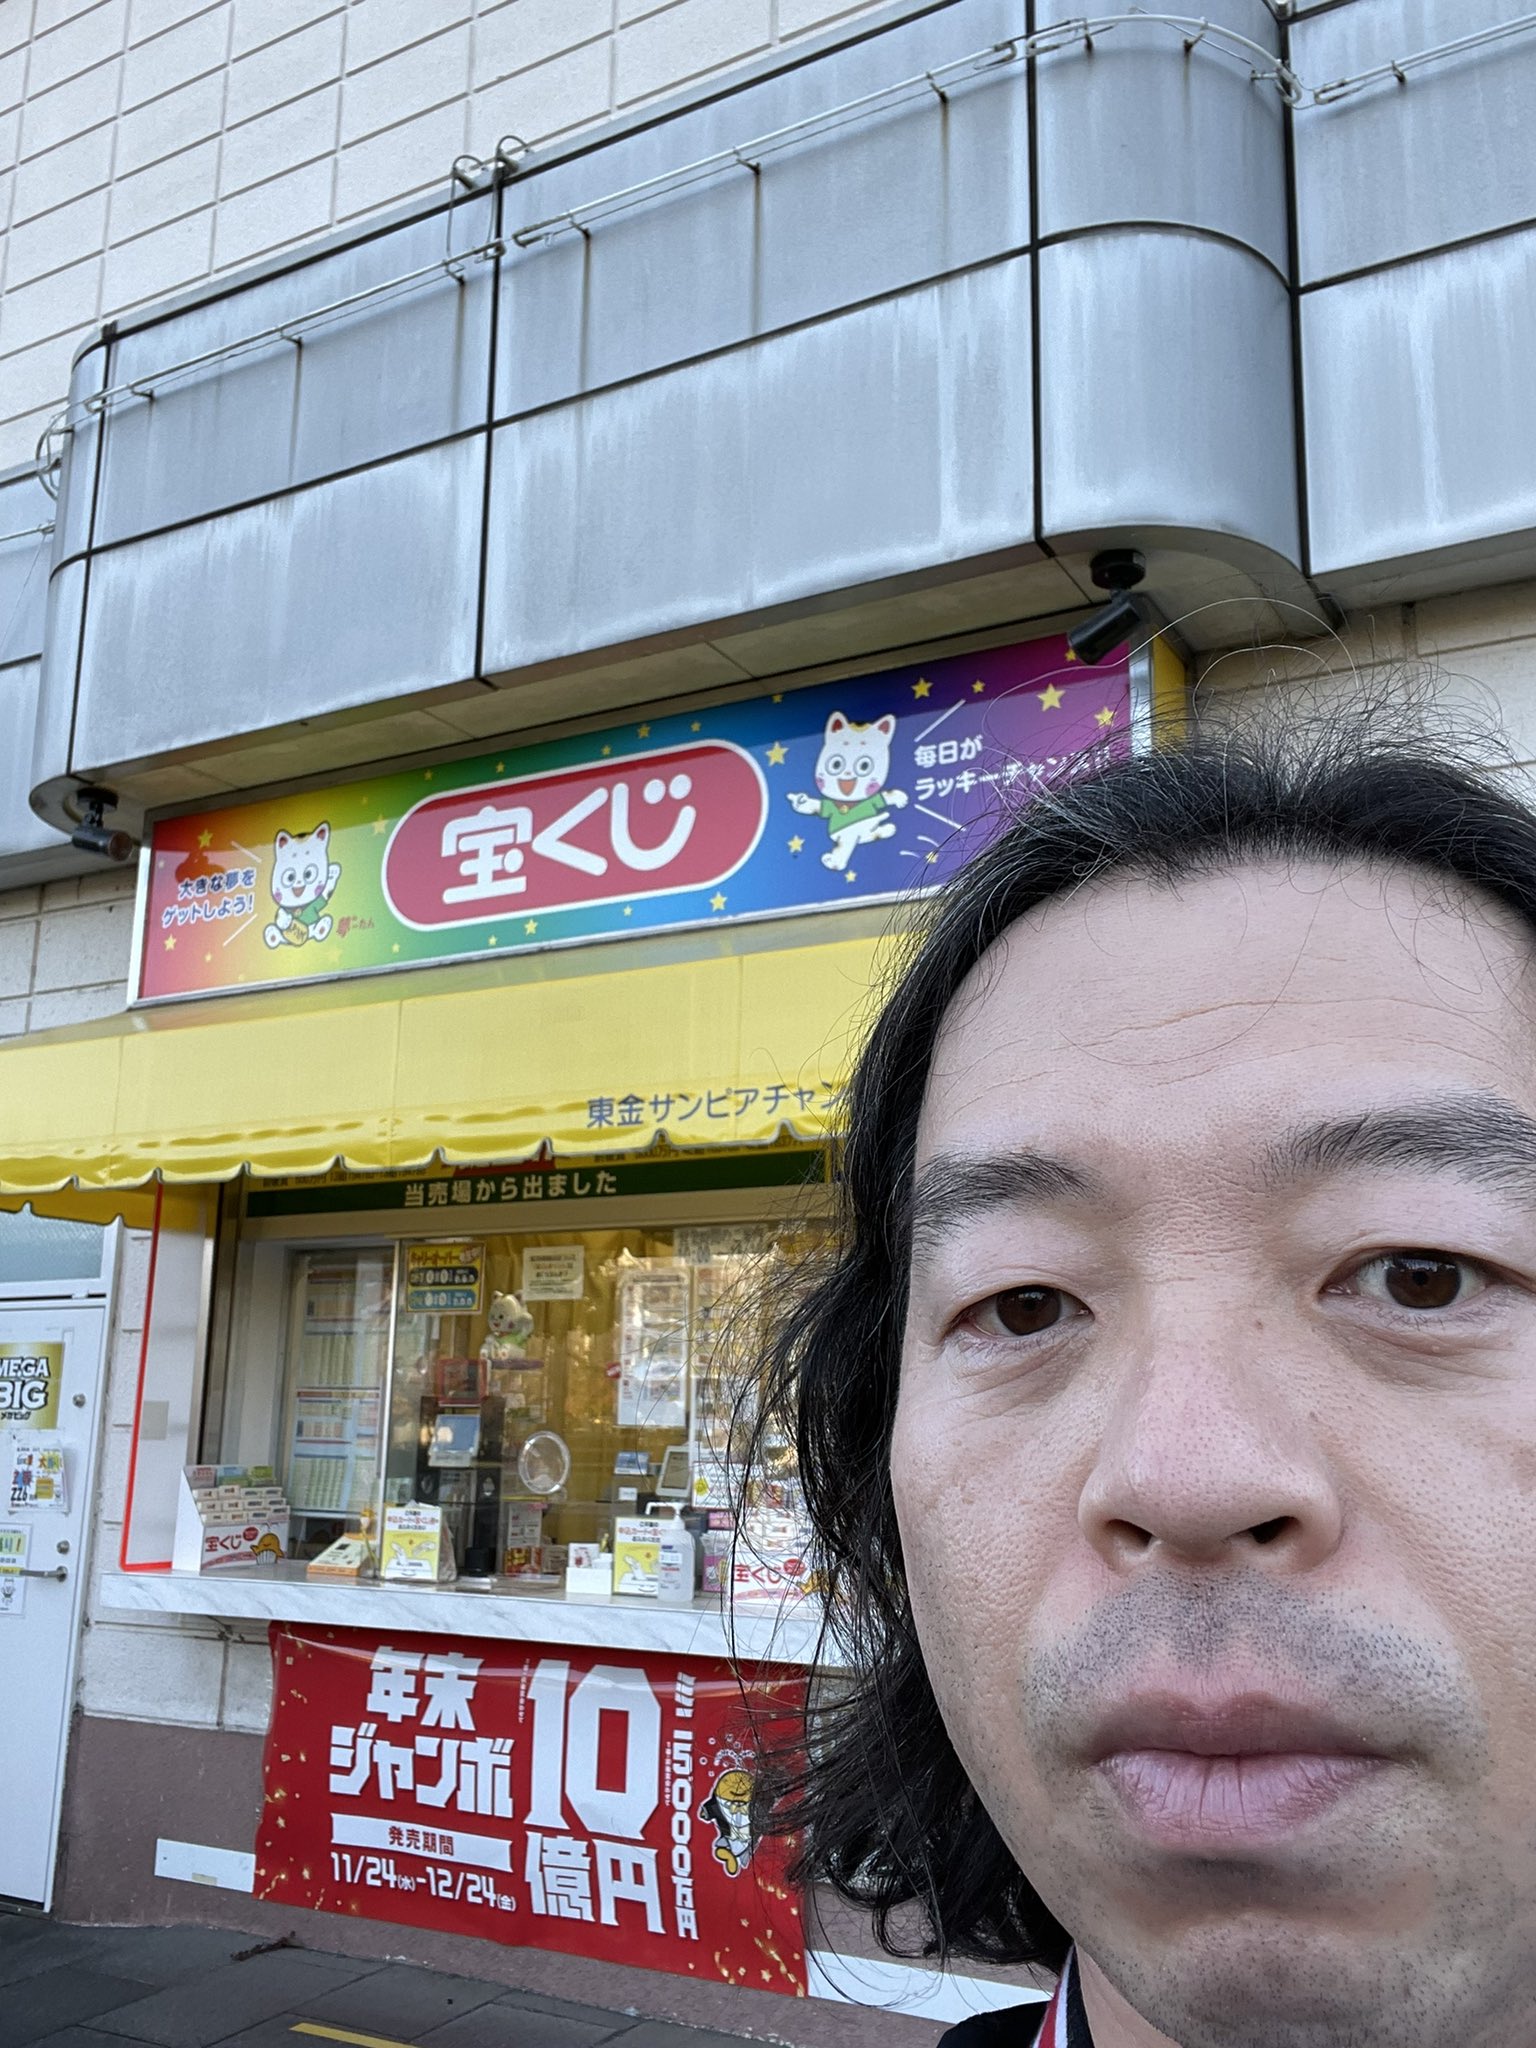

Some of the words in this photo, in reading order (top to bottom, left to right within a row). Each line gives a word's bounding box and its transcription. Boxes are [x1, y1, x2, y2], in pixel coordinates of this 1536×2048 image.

[914, 734, 984, 768] 毎日が
[441, 773, 697, 905] 宝くじ
[178, 869, 256, 899] 大きな夢を
[403, 1170, 618, 1208] 当売場から出ました
[366, 1646, 485, 1732] 年末
[329, 1723, 514, 1819] ジャンボ
[524, 1659, 662, 1840] 10
[388, 1825, 454, 1856] 発売期間
[524, 1830, 666, 1935] 億円
